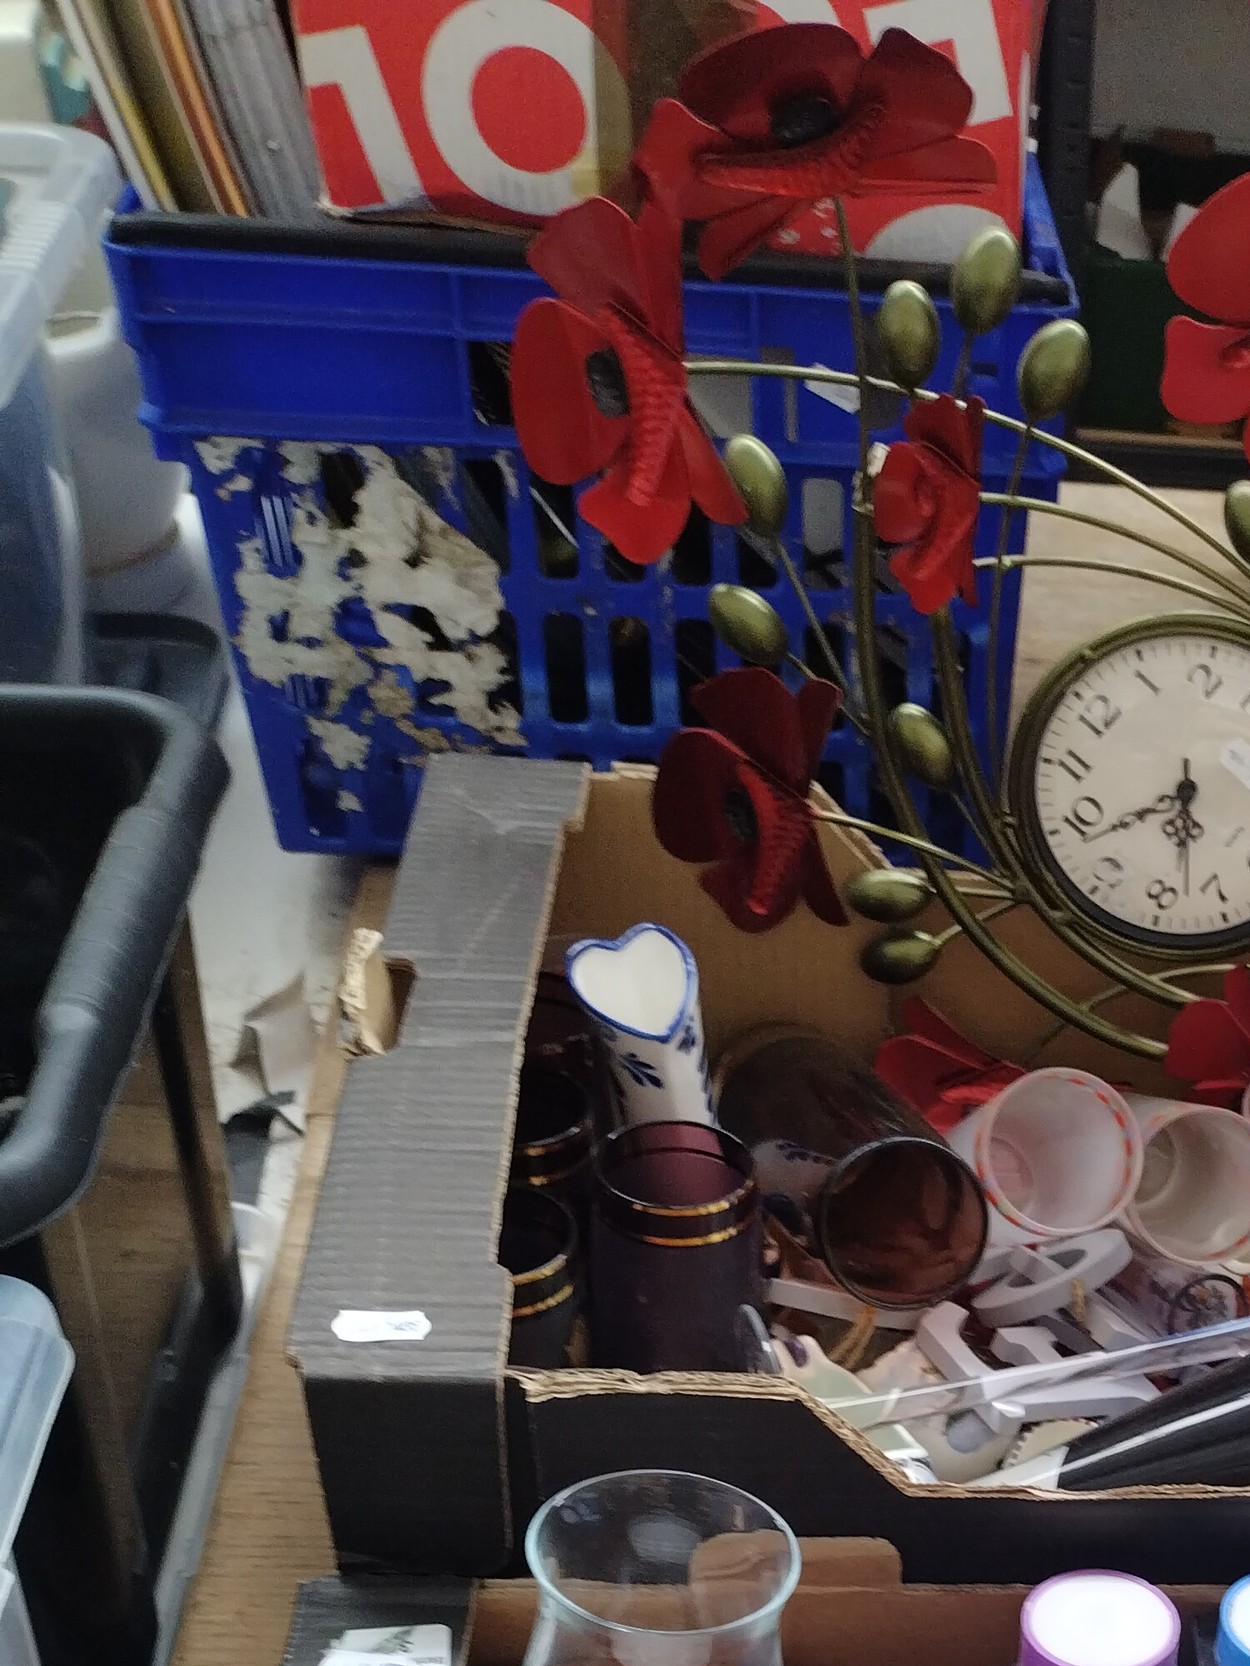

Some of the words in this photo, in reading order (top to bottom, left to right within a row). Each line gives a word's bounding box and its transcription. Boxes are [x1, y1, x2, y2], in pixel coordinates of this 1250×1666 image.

[1135, 670, 1161, 696] 1
[1187, 664, 1223, 697] 2
[1079, 695, 1122, 737] 12
[1058, 750, 1093, 783] 11
[1063, 796, 1104, 841] 10
[1146, 879, 1179, 911] 8
[1200, 873, 1228, 904] 7
